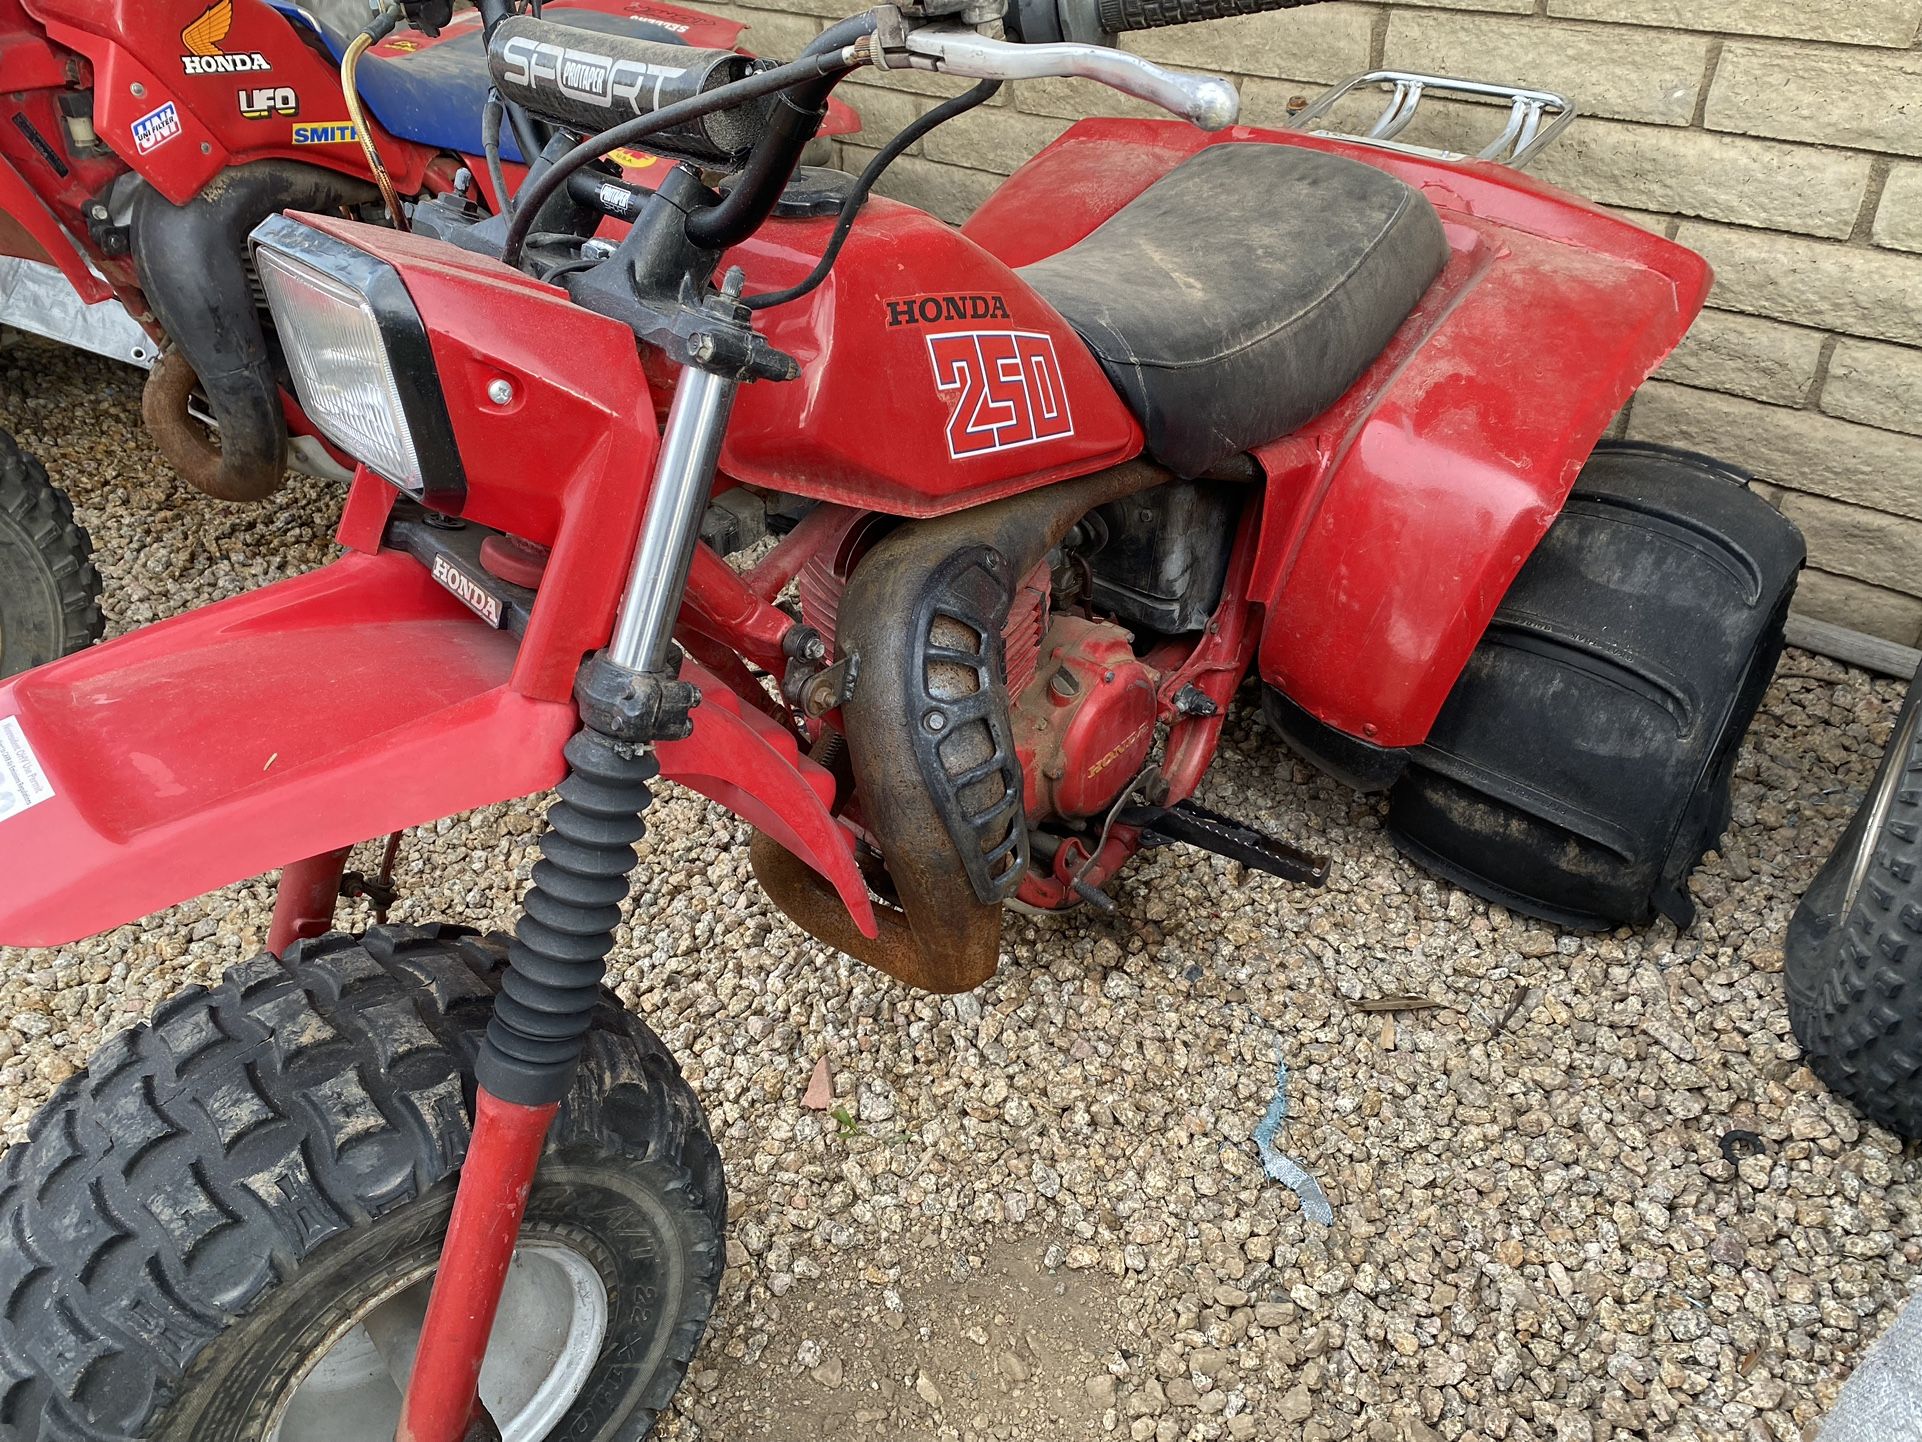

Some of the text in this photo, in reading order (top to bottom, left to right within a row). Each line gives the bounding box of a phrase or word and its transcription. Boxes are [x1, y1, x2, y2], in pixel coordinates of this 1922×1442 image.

[181, 53, 271, 74] HONDA
[503, 36, 687, 115] SPORT
[562, 61, 606, 94] PROTAPER
[238, 87, 296, 117] UFO
[137, 115, 174, 142] UNI FILTER
[886, 295, 1011, 327] HONDA
[925, 330, 1075, 460] 250
[432, 556, 498, 623] HONDA
[1087, 722, 1149, 779] HONDA
